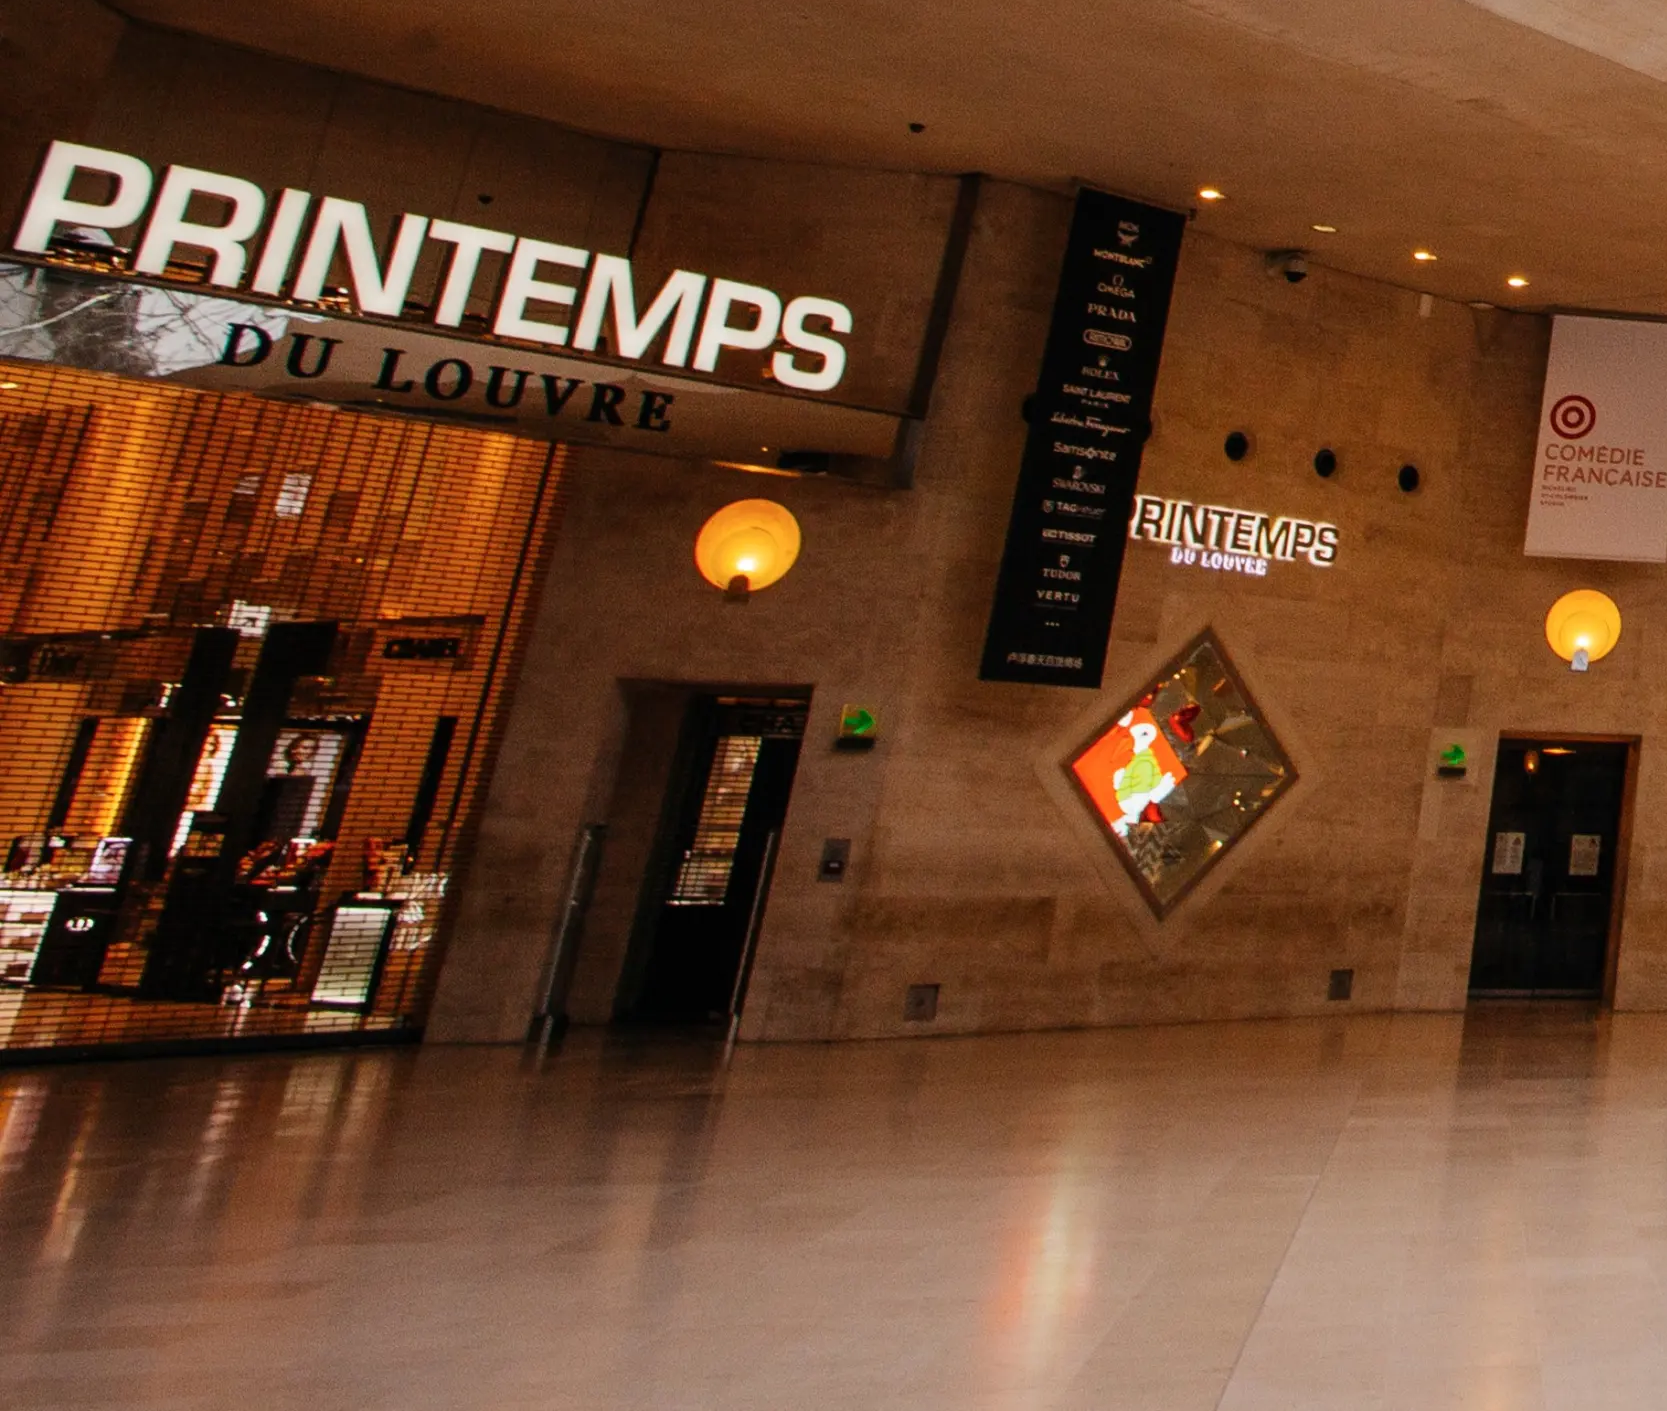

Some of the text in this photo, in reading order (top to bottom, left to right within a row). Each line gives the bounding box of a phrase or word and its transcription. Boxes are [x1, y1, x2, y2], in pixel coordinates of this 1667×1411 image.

[14, 140, 854, 391] PRINTEMPS
[1097, 282, 1136, 299] OMEGA
[1087, 302, 1137, 323] PRADA
[219, 323, 676, 434] DU LOUVRE
[1081, 366, 1120, 381] ROLEX
[1545, 443, 1646, 466] COMÉDIE
[1542, 464, 1667, 489] FRANÇAISE
[1131, 494, 1340, 567] RINTEMPS
[1170, 546, 1197, 566] DU
[1043, 568, 1082, 581] TUDOR
[1036, 589, 1080, 603] VERTU
